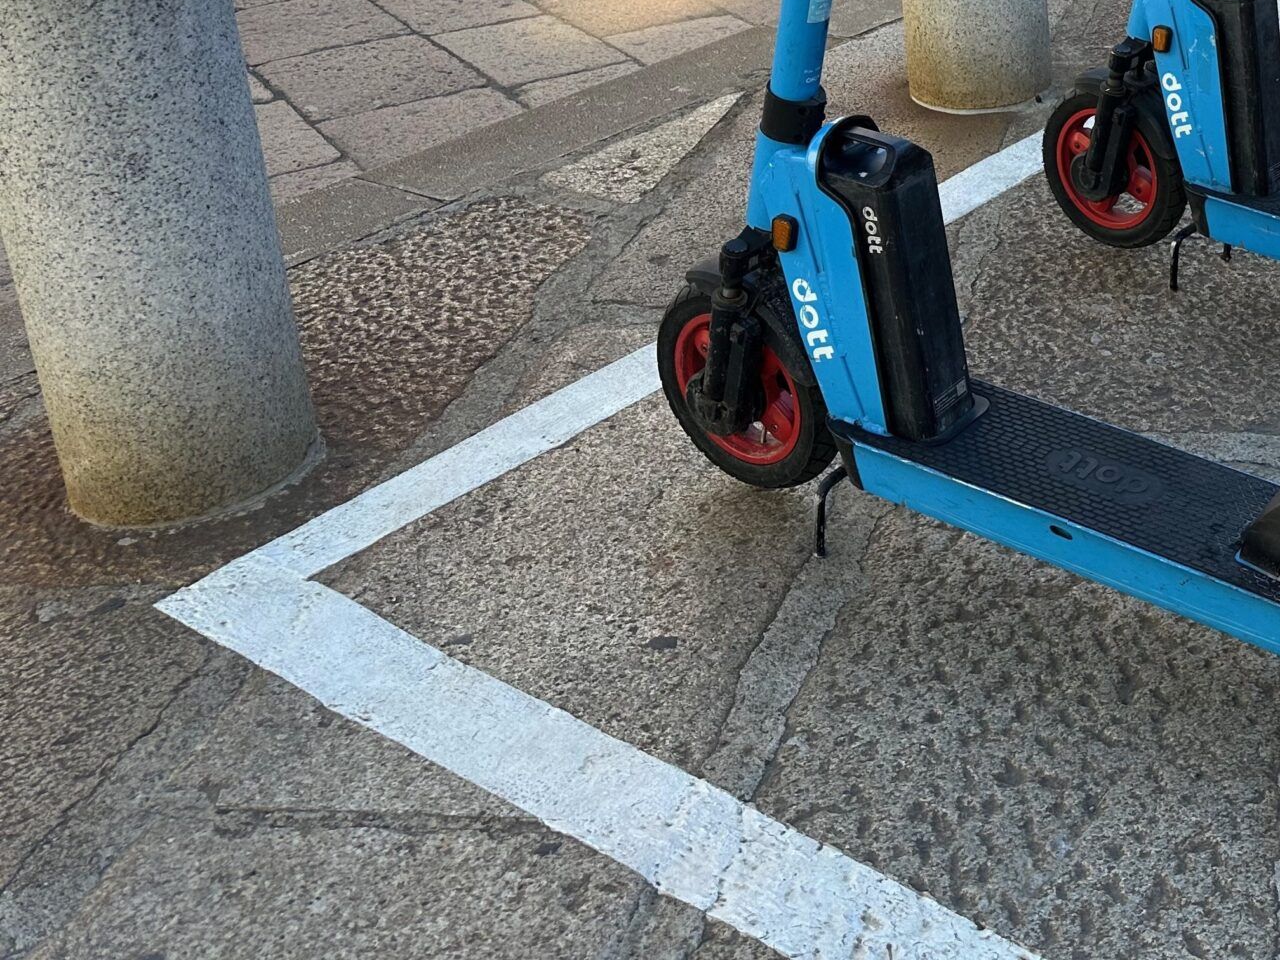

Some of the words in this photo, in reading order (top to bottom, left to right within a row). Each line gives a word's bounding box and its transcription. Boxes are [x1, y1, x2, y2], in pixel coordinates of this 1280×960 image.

[1162, 72, 1193, 138] dott
[862, 206, 883, 255] dott
[792, 278, 836, 363] dott
